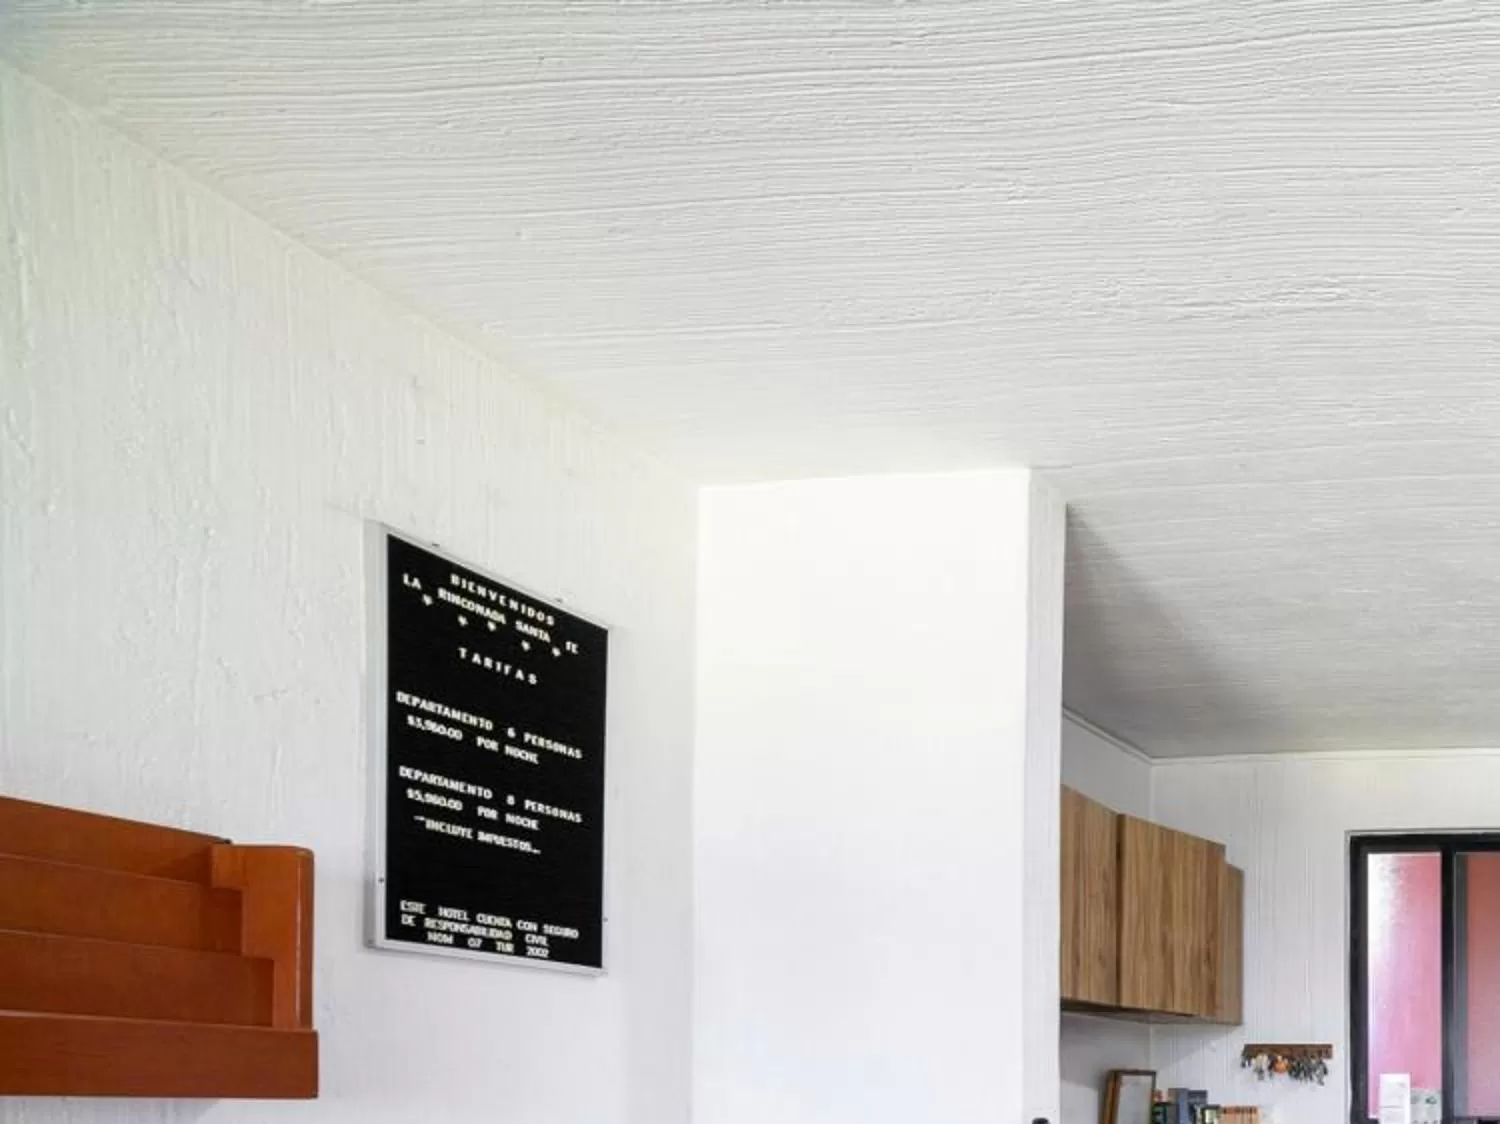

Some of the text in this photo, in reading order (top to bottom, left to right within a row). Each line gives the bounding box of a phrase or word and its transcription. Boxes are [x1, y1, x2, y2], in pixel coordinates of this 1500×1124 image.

[403, 573, 579, 655] LA RINCONADA SANTA FE
[451, 574, 555, 626] BIENVENIDOS
[458, 647, 538, 685] TARIFAS
[396, 691, 493, 731] DEPARTAMENTO
[524, 732, 582, 759] PERSONAS
[477, 736, 499, 752] POR
[505, 745, 539, 764] NOCHE
[399, 766, 493, 799] DEPARTAMENTO
[525, 800, 582, 823] PERSONAS
[477, 806, 498, 819] POR
[506, 813, 539, 831] NOCHE
[400, 900, 579, 938] ESTE HOTEL CUENTA CON SEGURO
[401, 914, 416, 927] DE
[525, 934, 549, 947] CIVIL
[427, 931, 453, 944] NOM
[496, 941, 514, 953] TUR
